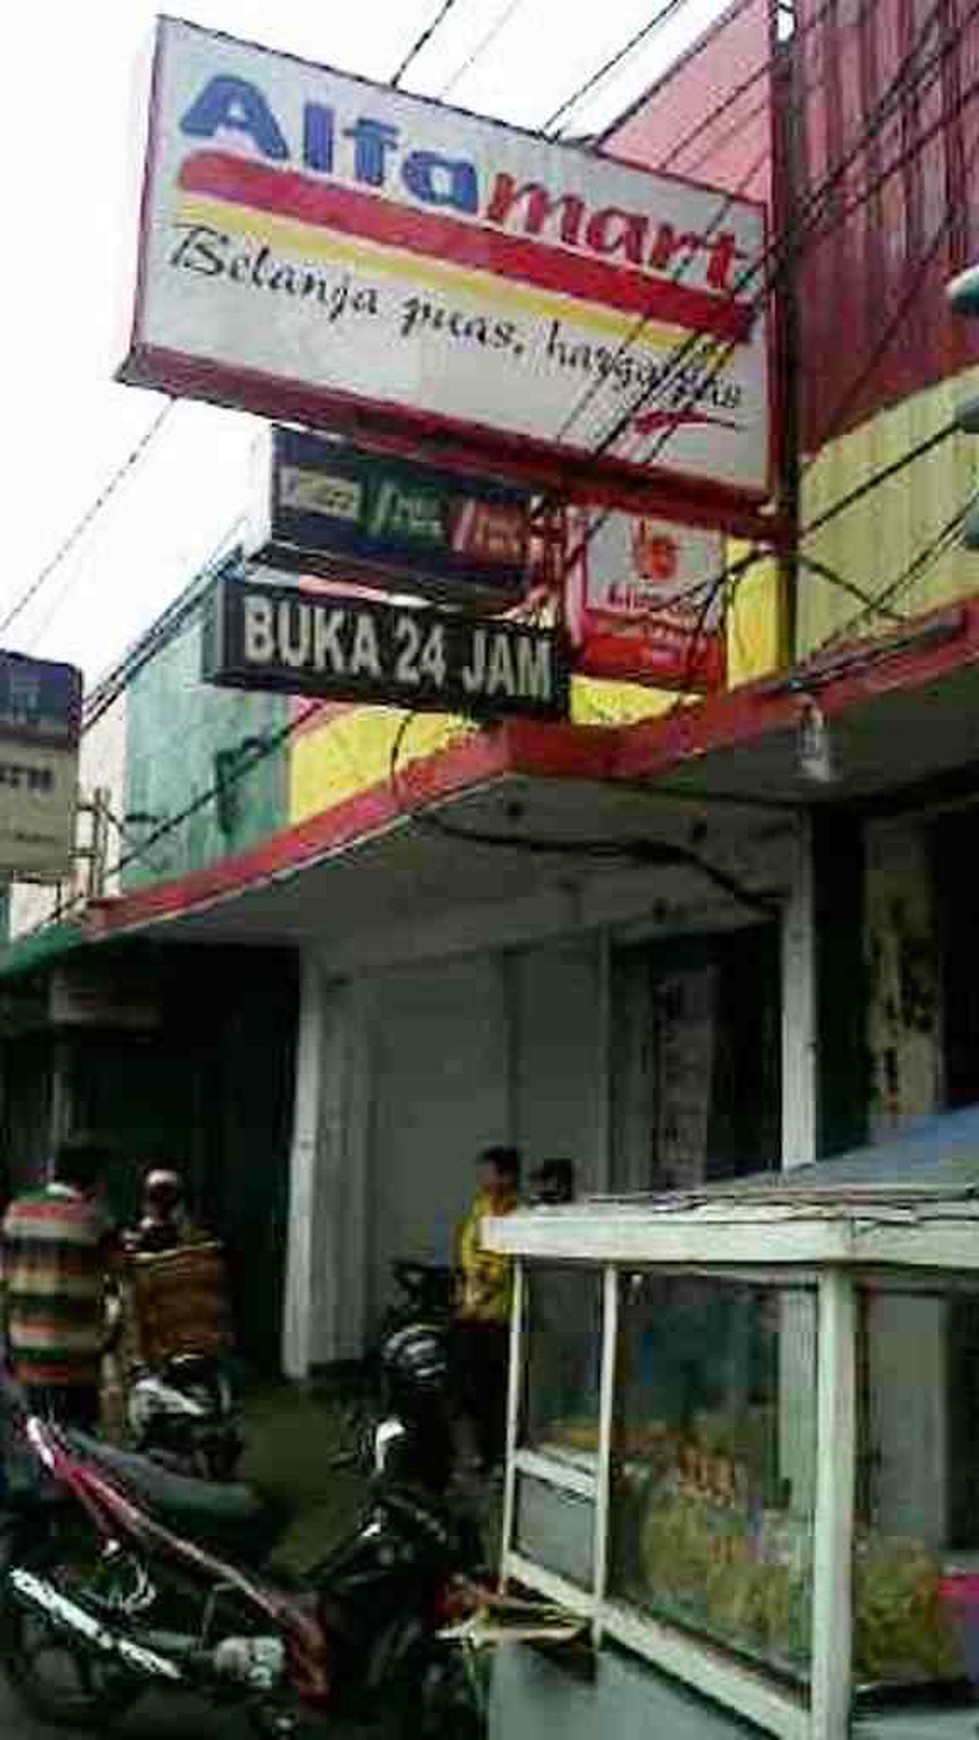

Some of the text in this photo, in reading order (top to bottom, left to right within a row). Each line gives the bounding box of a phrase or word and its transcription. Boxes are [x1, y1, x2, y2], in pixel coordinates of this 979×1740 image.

[179, 73, 744, 290] Alfamart
[168, 223, 379, 324] Belanja
[401, 296, 525, 355] puas,
[243, 598, 381, 677] BUKA
[398, 618, 448, 688] 24
[462, 628, 551, 699] JAM
